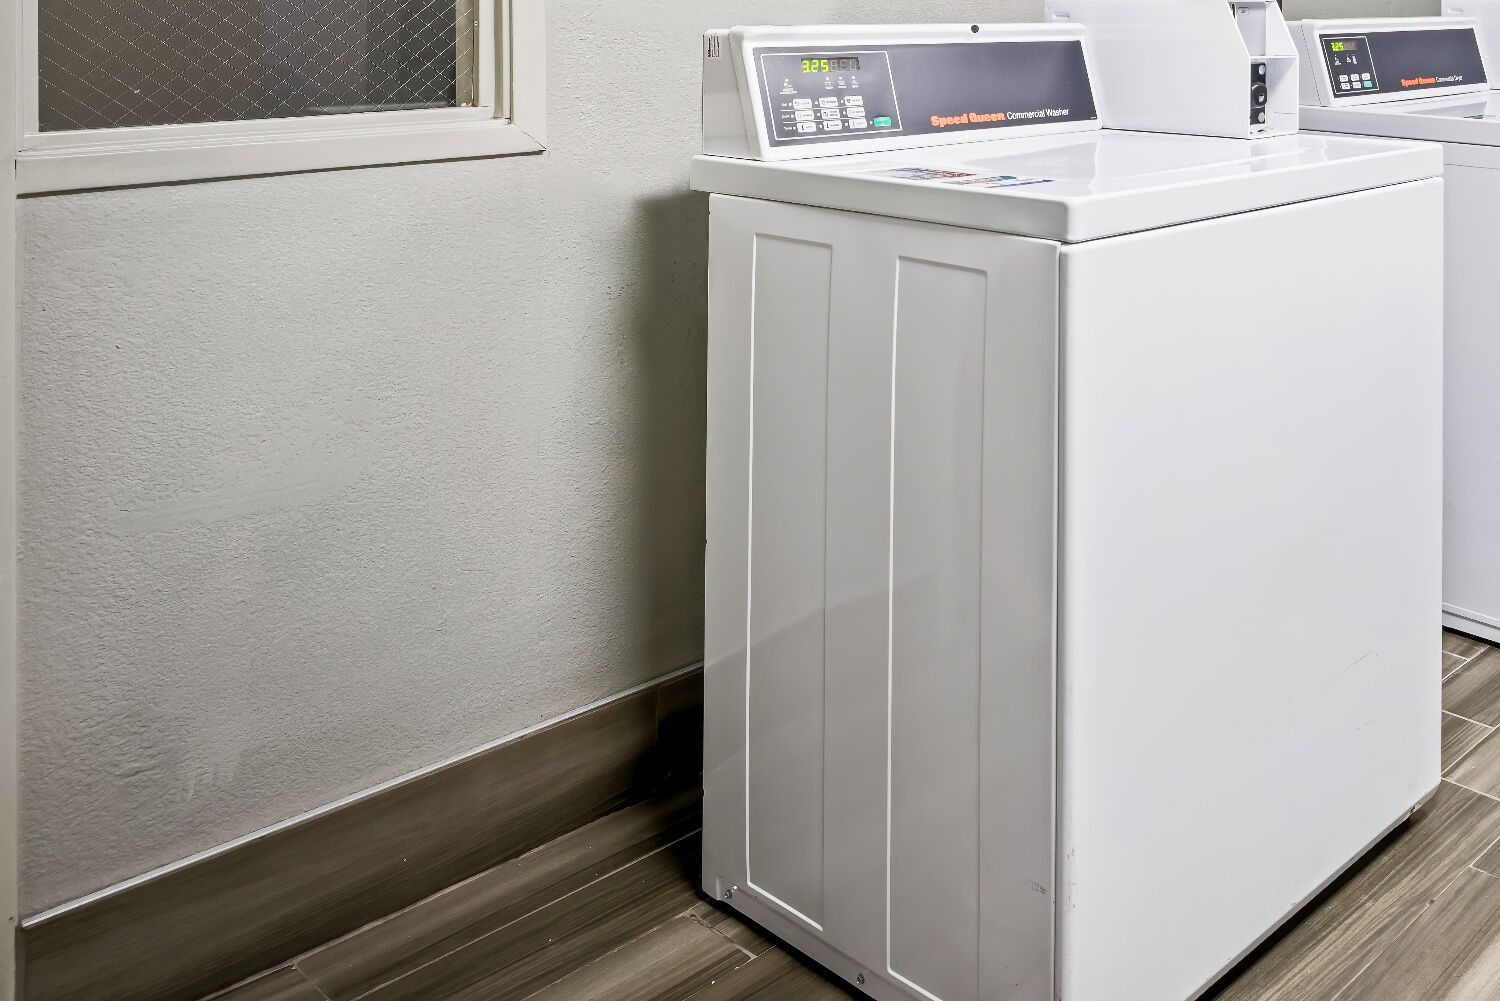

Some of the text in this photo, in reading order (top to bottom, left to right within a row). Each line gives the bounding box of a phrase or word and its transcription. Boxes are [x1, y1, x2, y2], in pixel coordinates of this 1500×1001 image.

[802, 59, 829, 73] 325
[930, 107, 1069, 128] Speed Queen Commercial Washer
